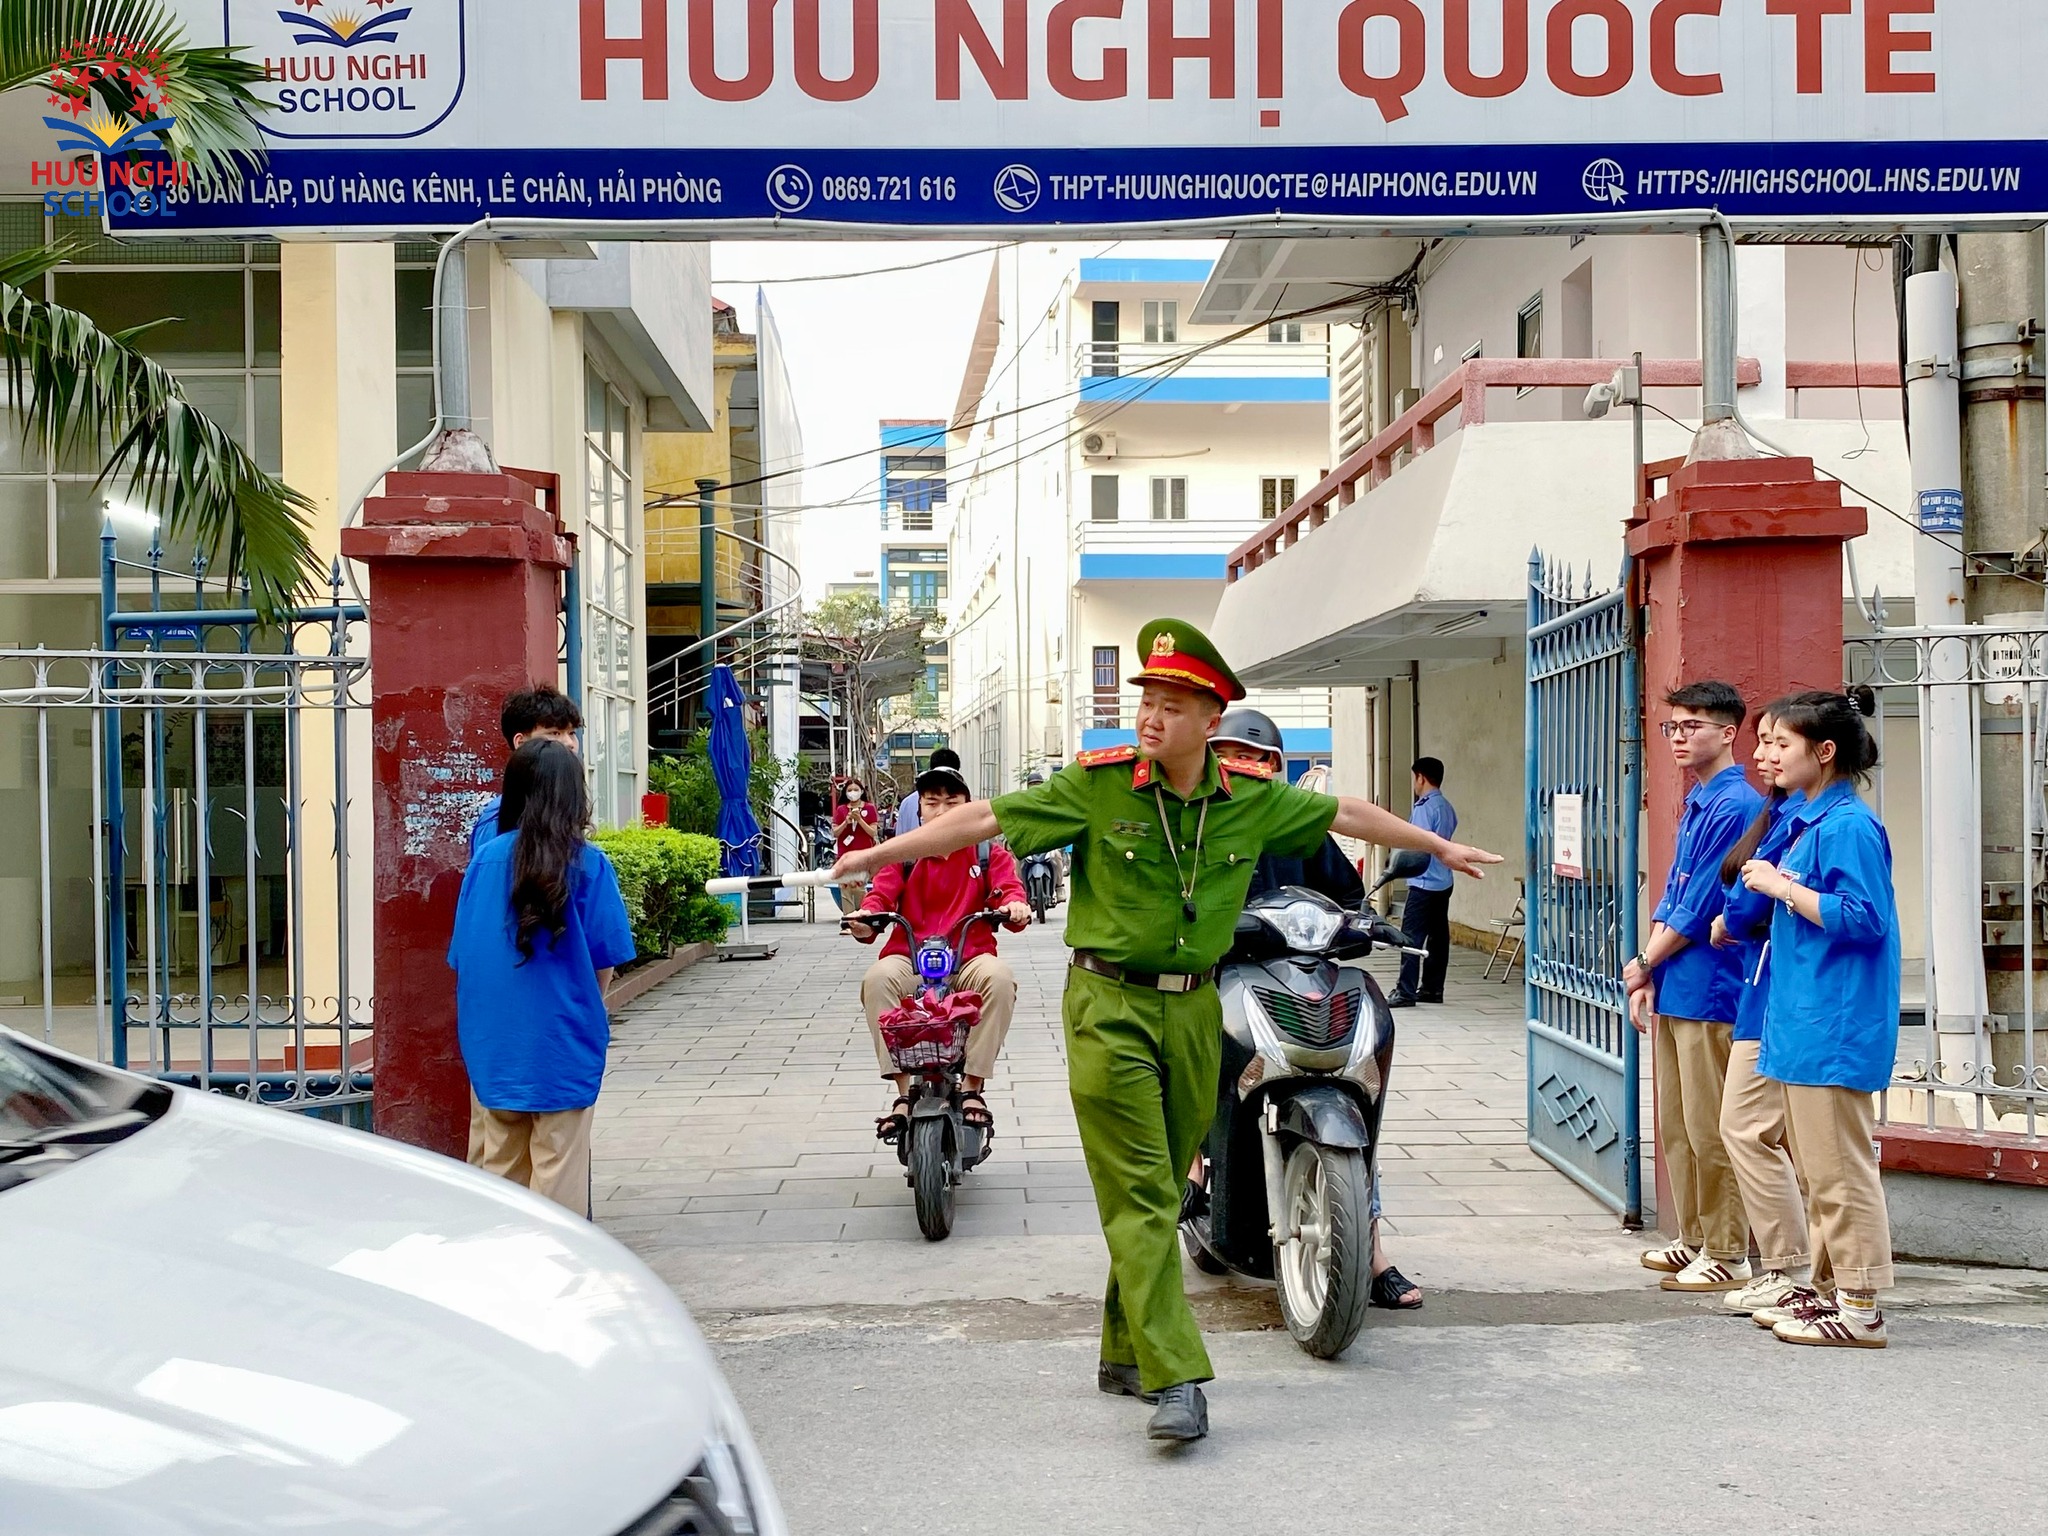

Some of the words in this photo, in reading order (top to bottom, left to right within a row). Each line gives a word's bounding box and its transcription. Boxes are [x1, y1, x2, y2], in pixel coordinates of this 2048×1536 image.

[265, 56, 335, 82] HUU
[347, 54, 426, 80] NGHI
[935, 0, 1283, 127] NGHỊ
[278, 86, 416, 113] SCHOOL
[250, 172, 297, 208] LẬP,
[303, 175, 335, 203] DƯ
[341, 172, 406, 203] HÀNG
[412, 172, 482, 207] KÊNH,
[488, 171, 516, 203] LÊ
[522, 172, 592, 207] CHÂN,
[598, 169, 636, 203] HẢI
[642, 171, 722, 203] PHÒNG
[822, 176, 911, 201] 0869.721
[919, 176, 956, 201] 616
[1049, 170, 1537, 200] THPT-HUUNGHIQUOCTE@HAIPHONG.EDU.VN
[1637, 167, 2021, 195] HTTPS://HIGHSCHOOL.HNS.EDU.VN
